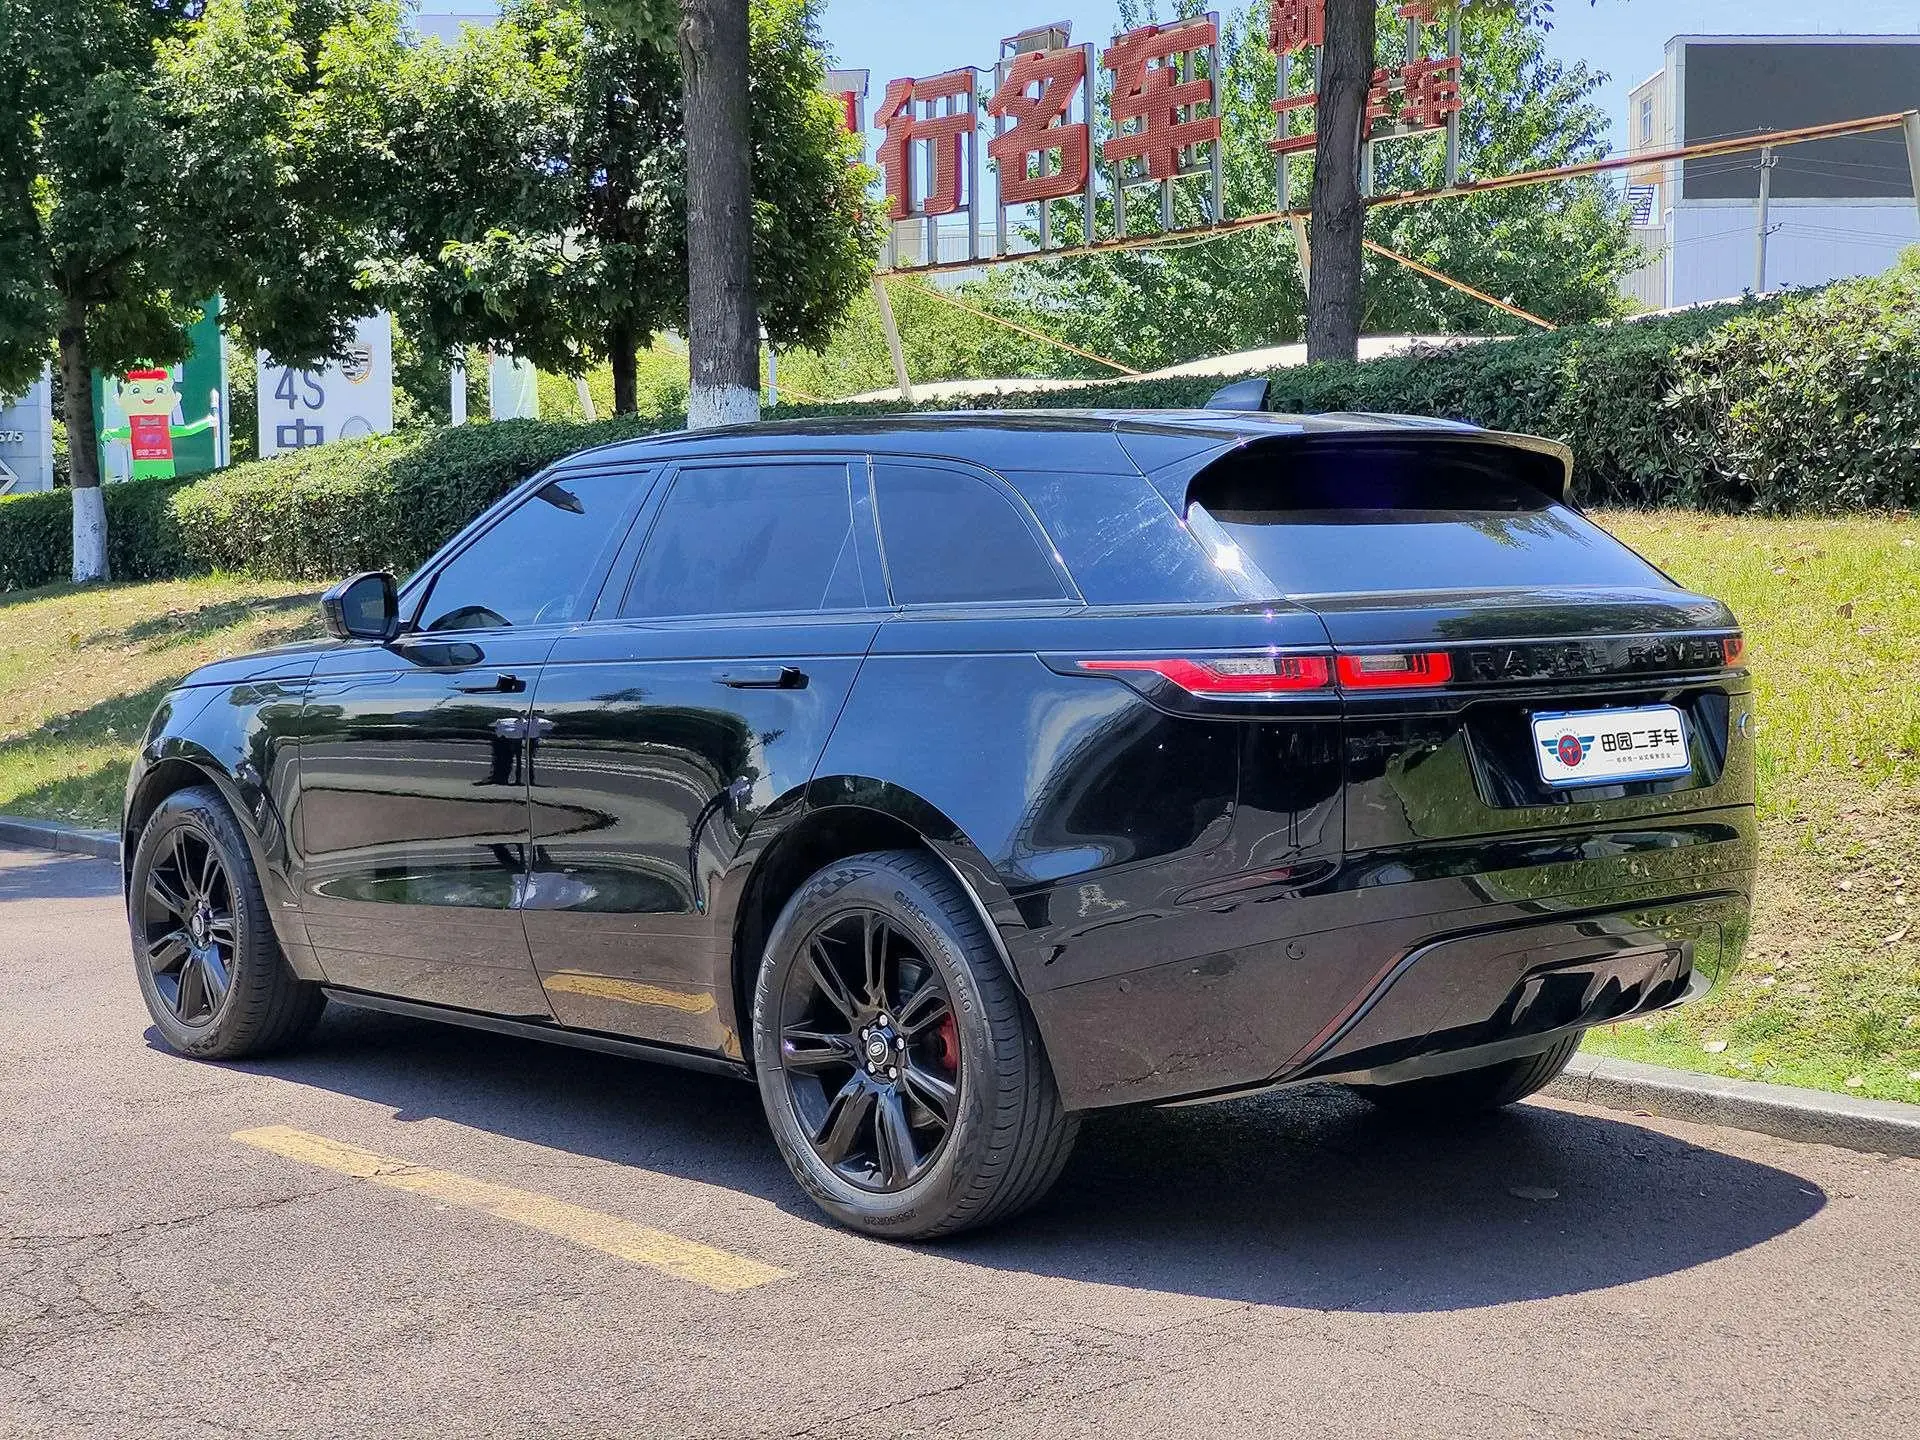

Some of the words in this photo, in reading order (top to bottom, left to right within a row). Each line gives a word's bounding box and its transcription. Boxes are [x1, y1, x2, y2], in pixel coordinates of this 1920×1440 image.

[843, 22, 1222, 221] 行名车
[275, 367, 325, 410] 4S
[1628, 641, 1721, 664] ROVER
[1601, 728, 1680, 752] 田园二手车
